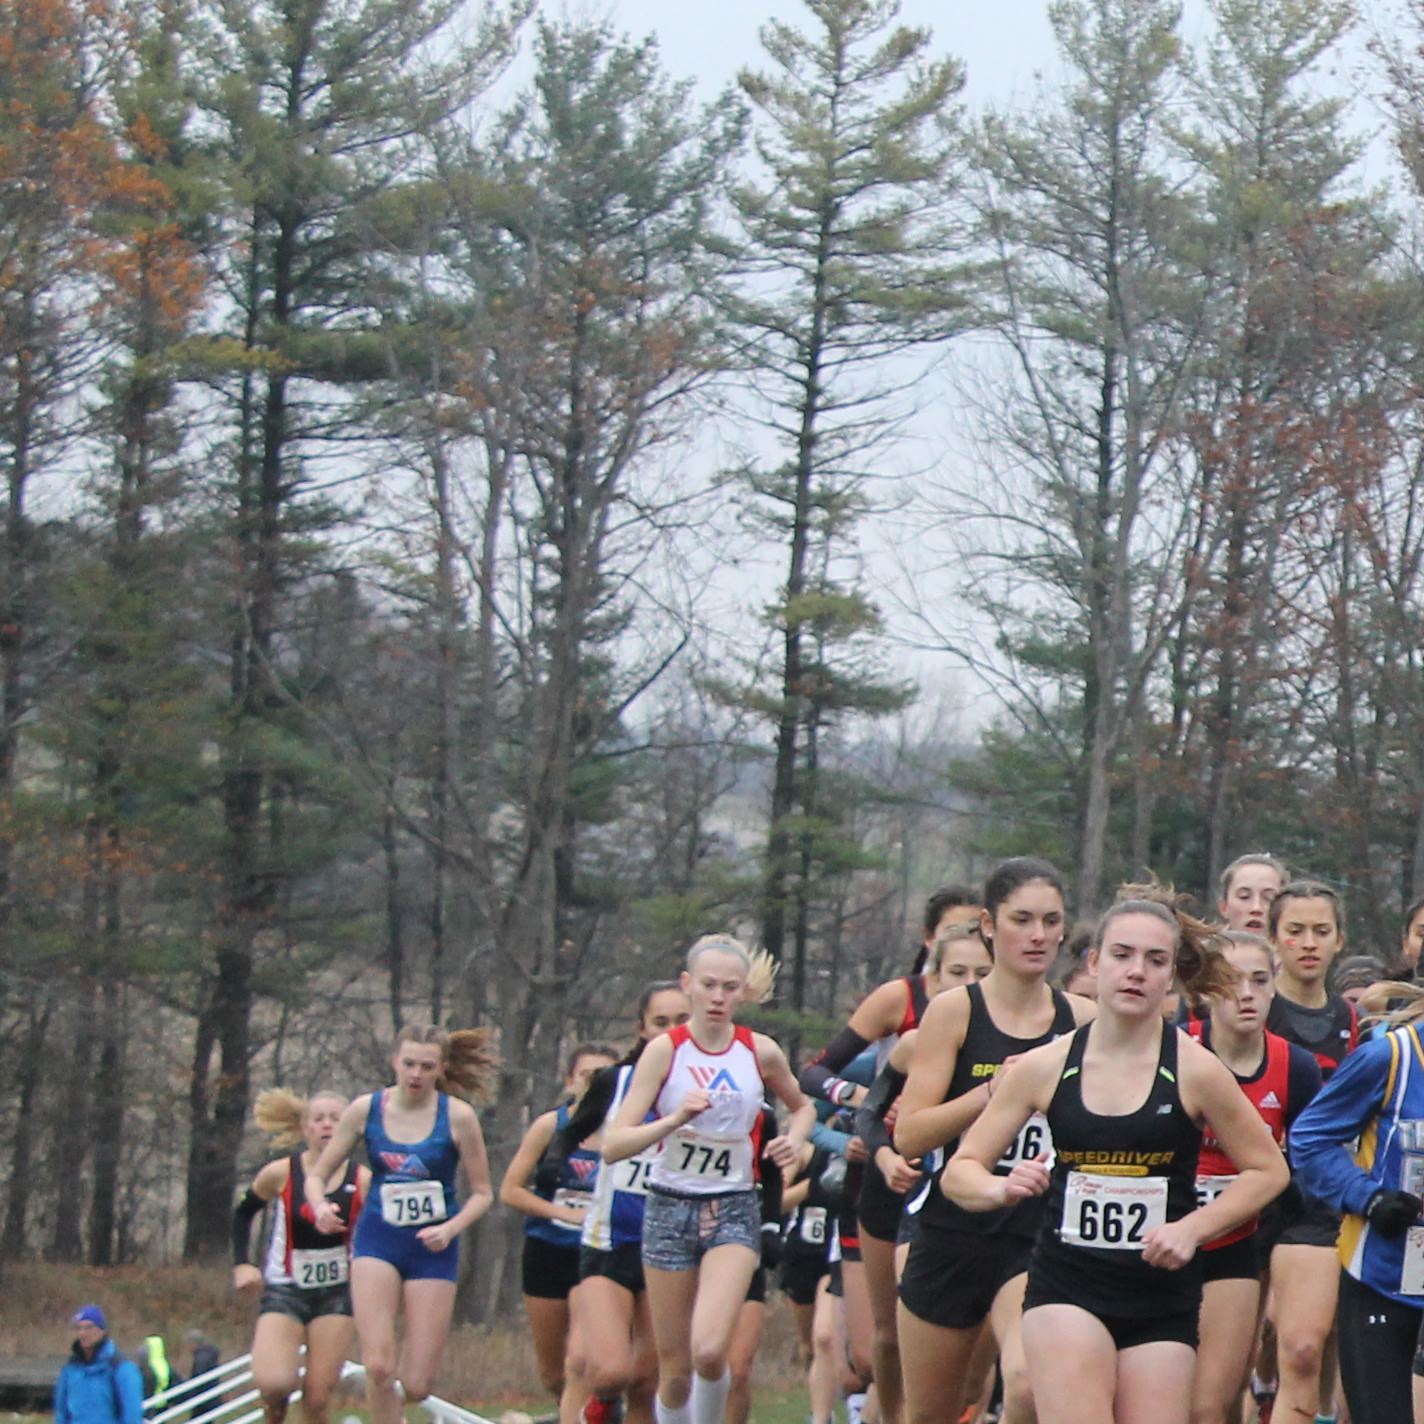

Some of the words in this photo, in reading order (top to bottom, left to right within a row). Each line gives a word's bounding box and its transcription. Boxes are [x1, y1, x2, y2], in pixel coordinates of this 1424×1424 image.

[681, 1142, 732, 1177] 774
[393, 1194, 435, 1221] 794
[1080, 1199, 1148, 1243] 662
[303, 1261, 339, 1284] 209
